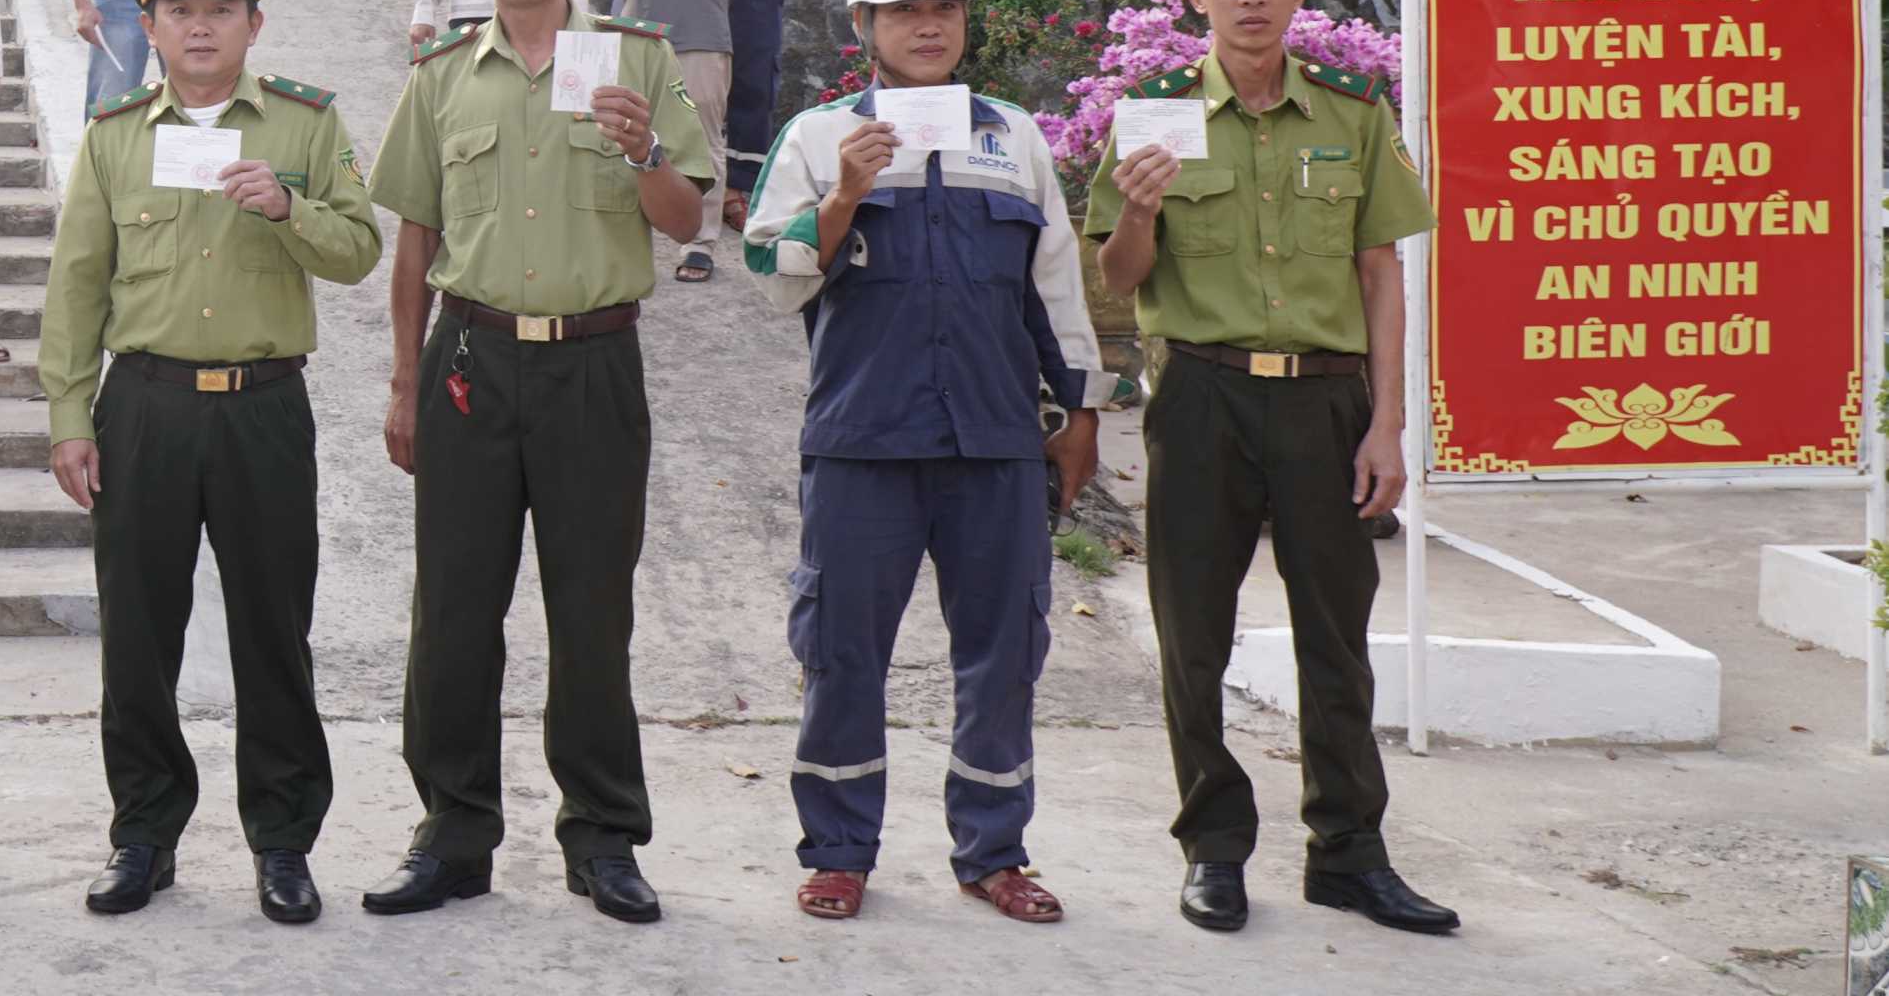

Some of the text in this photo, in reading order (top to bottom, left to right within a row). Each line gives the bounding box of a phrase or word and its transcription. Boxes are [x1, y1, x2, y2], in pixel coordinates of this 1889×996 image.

[1497, 16, 1780, 67] LUYỆN TÀI,
[1494, 76, 1799, 121] XUNG KÍCH,
[1510, 139, 1770, 184] SÁNG TẠO
[1465, 190, 1828, 241] VÌ CHỦ QUYỀN
[1536, 262, 1757, 300] AN NINH
[1524, 314, 1769, 359] BIÊN GIỚI
